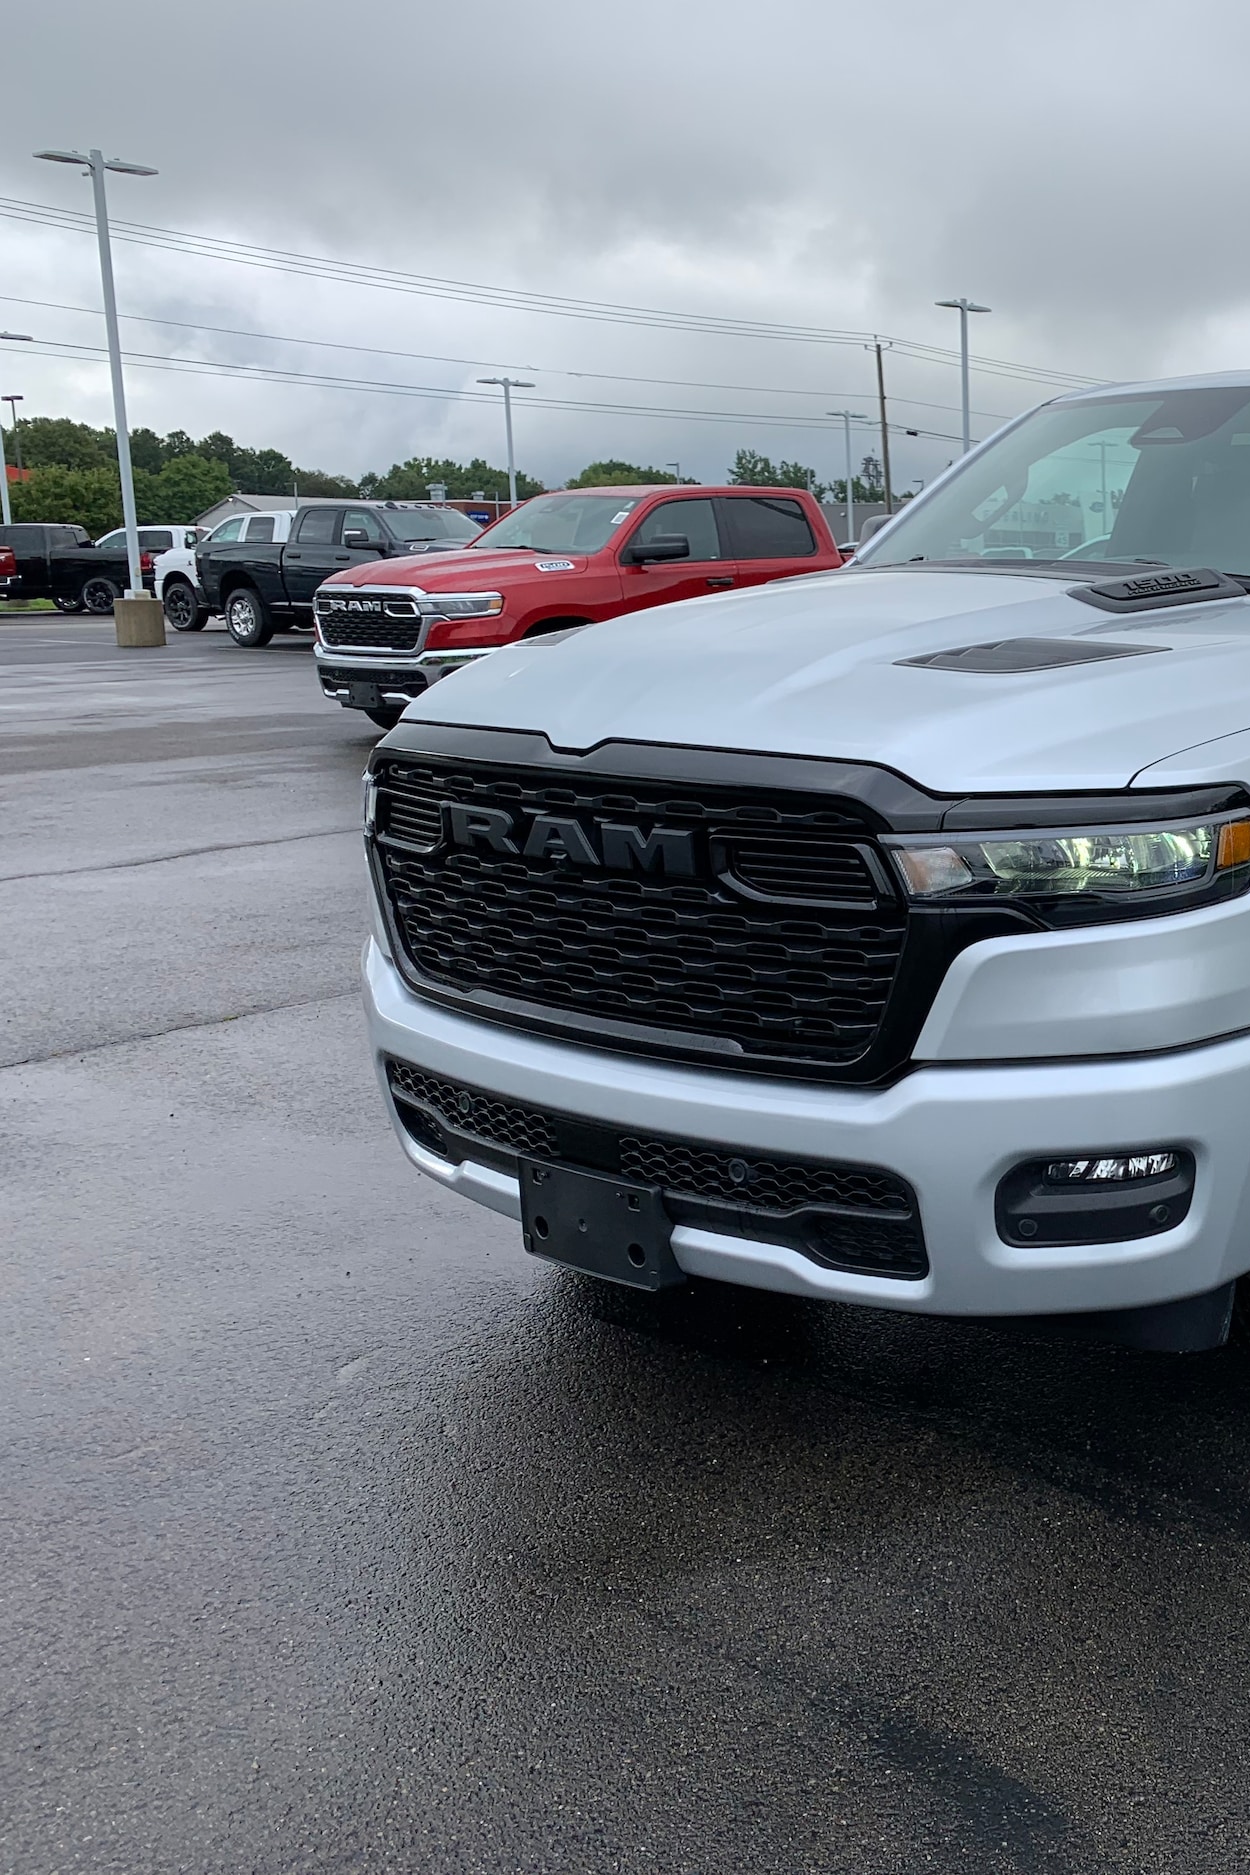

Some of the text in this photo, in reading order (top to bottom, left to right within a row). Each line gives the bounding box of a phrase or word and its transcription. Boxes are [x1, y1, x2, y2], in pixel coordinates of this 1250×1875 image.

[1122, 573, 1197, 591] 1500
[331, 600, 381, 611] RAM
[448, 802, 697, 876] RAM
